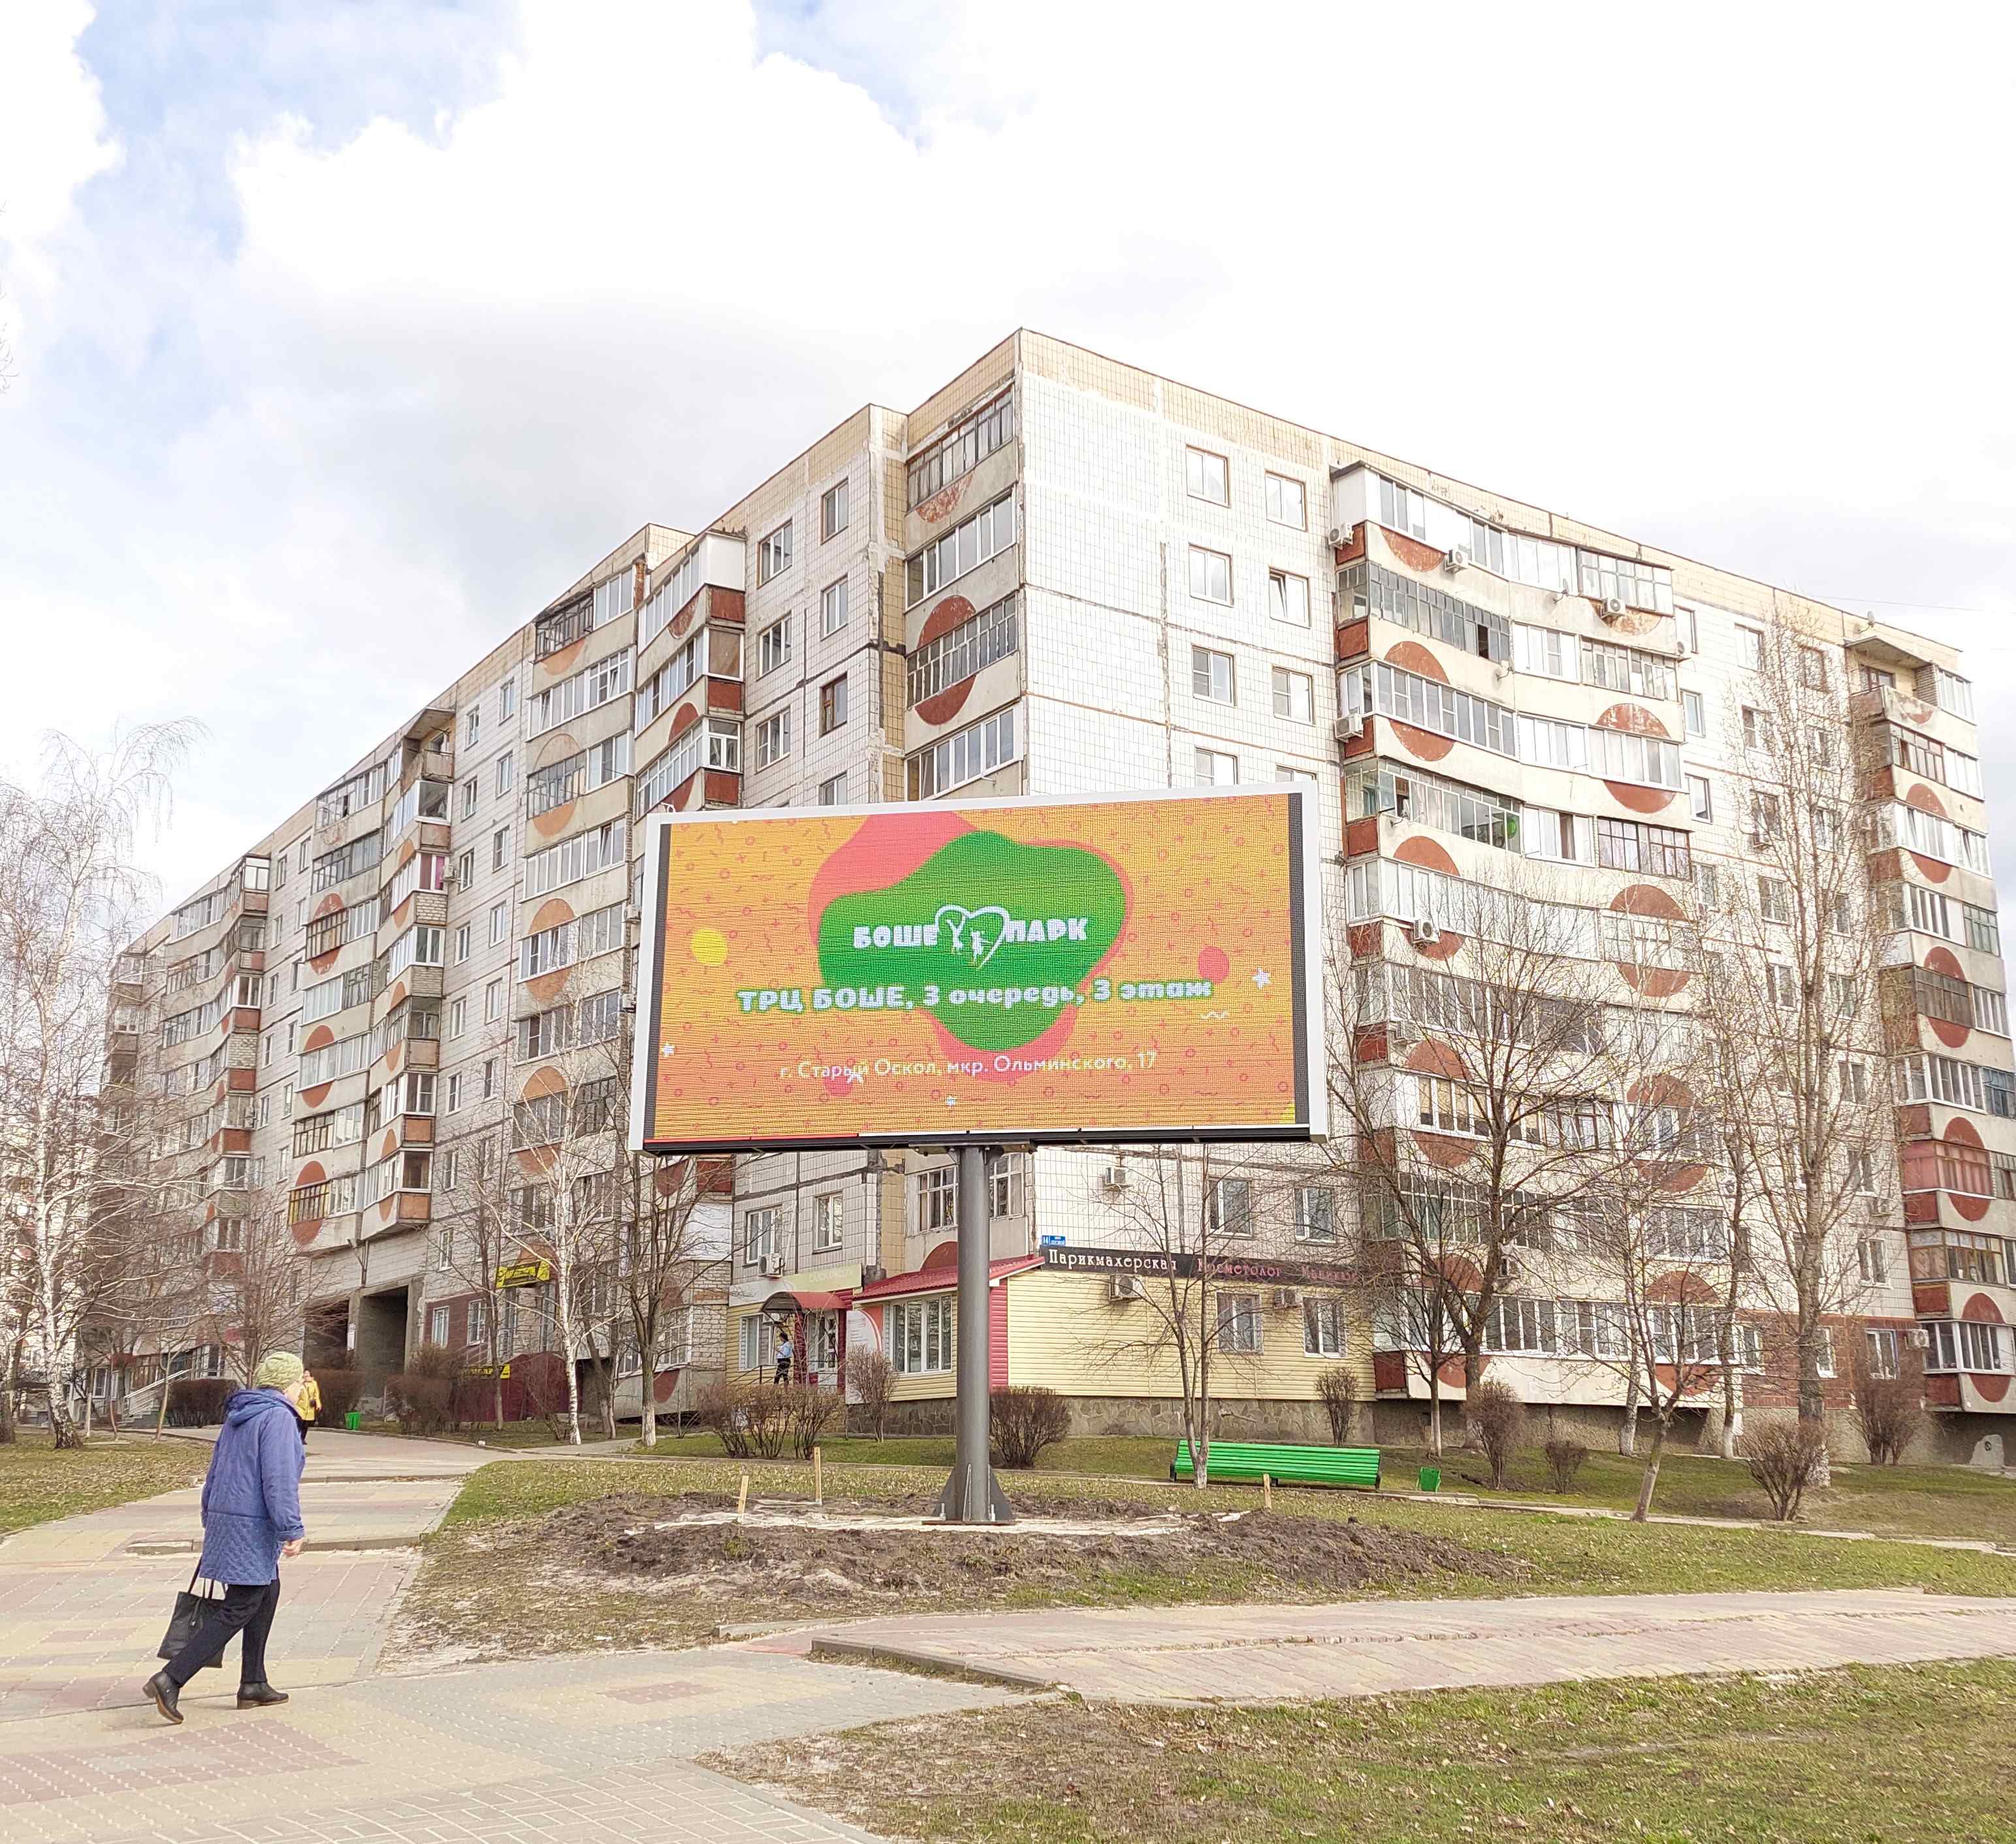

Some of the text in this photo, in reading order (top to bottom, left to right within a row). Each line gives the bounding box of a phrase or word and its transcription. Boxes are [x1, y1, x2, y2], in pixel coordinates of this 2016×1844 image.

[854, 917, 1087, 948] БОШЕ ПАРК
[737, 979, 1211, 1012] ТРЦ БОШЕ, 3 очередь, 3 этаж
[797, 1060, 868, 1081] Старый
[874, 1058, 941, 1076] Оскол,
[948, 1060, 989, 1077] мкр.
[994, 1055, 1133, 1072] Ольминского,
[1138, 1048, 1157, 1068] 17
